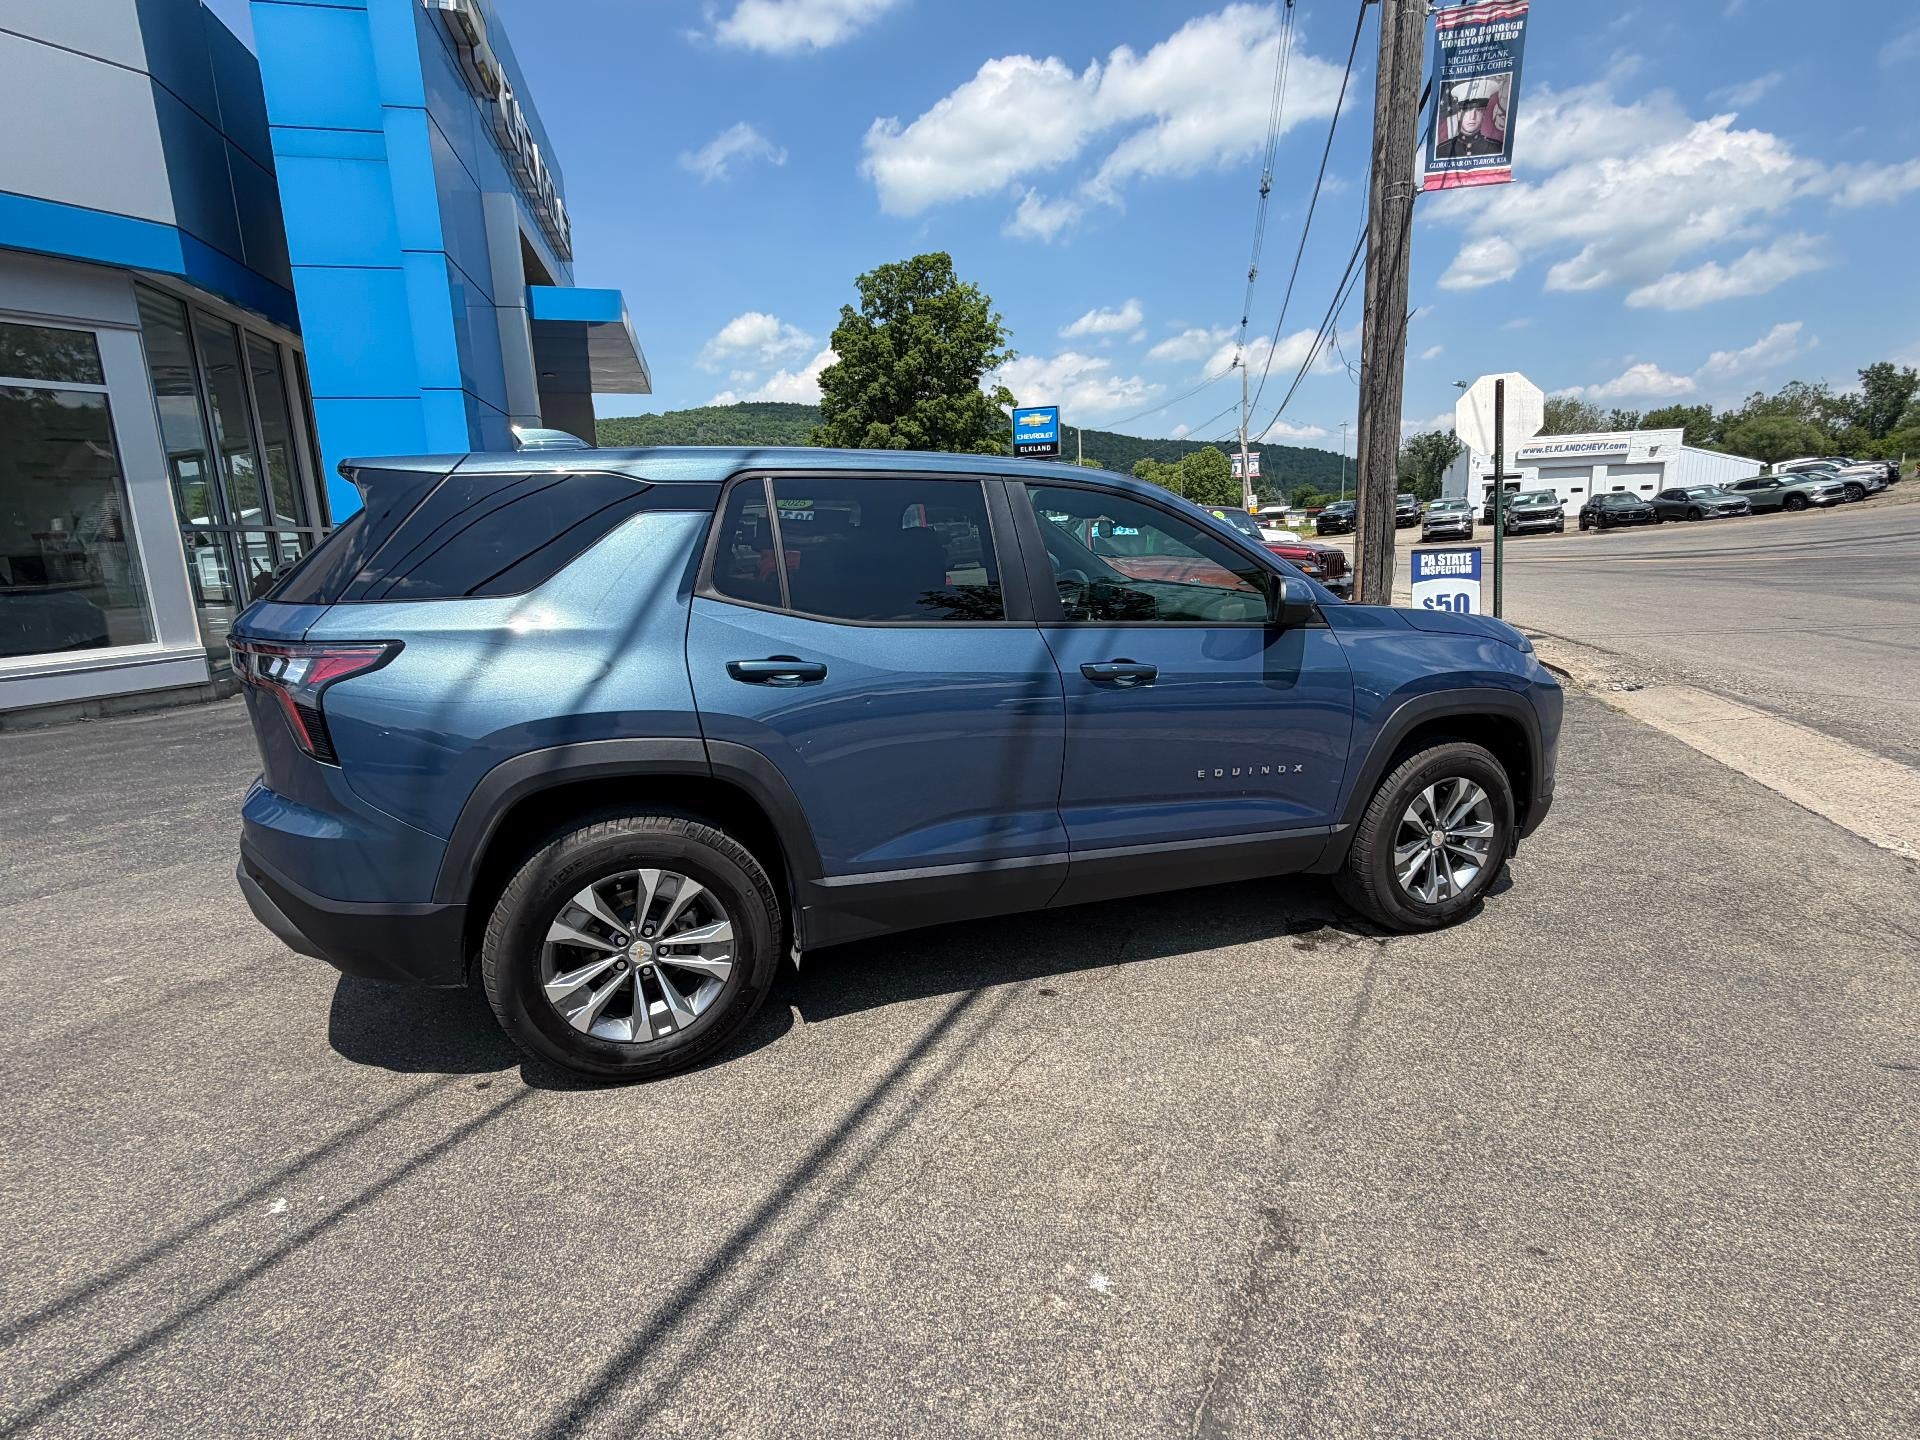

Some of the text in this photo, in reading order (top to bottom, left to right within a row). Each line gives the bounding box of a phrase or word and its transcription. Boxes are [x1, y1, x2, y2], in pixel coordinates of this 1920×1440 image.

[1438, 21, 1524, 41] ELKLAND BOROUGH
[1441, 34, 1491, 49] HOMETOWN
[1494, 30, 1519, 42] HERO
[1448, 54, 1482, 65] MICHAEL
[1455, 63, 1486, 74] MARINE
[1016, 431, 1054, 440] CHEVROLET
[1020, 444, 1051, 453] ELKLAND
[1522, 442, 1628, 455] www.ELKLANDCHEVY.com
[1420, 553, 1472, 566] PA STATE
[1420, 565, 1472, 575] INSPECTION
[1197, 764, 1303, 778] EQUINOX
